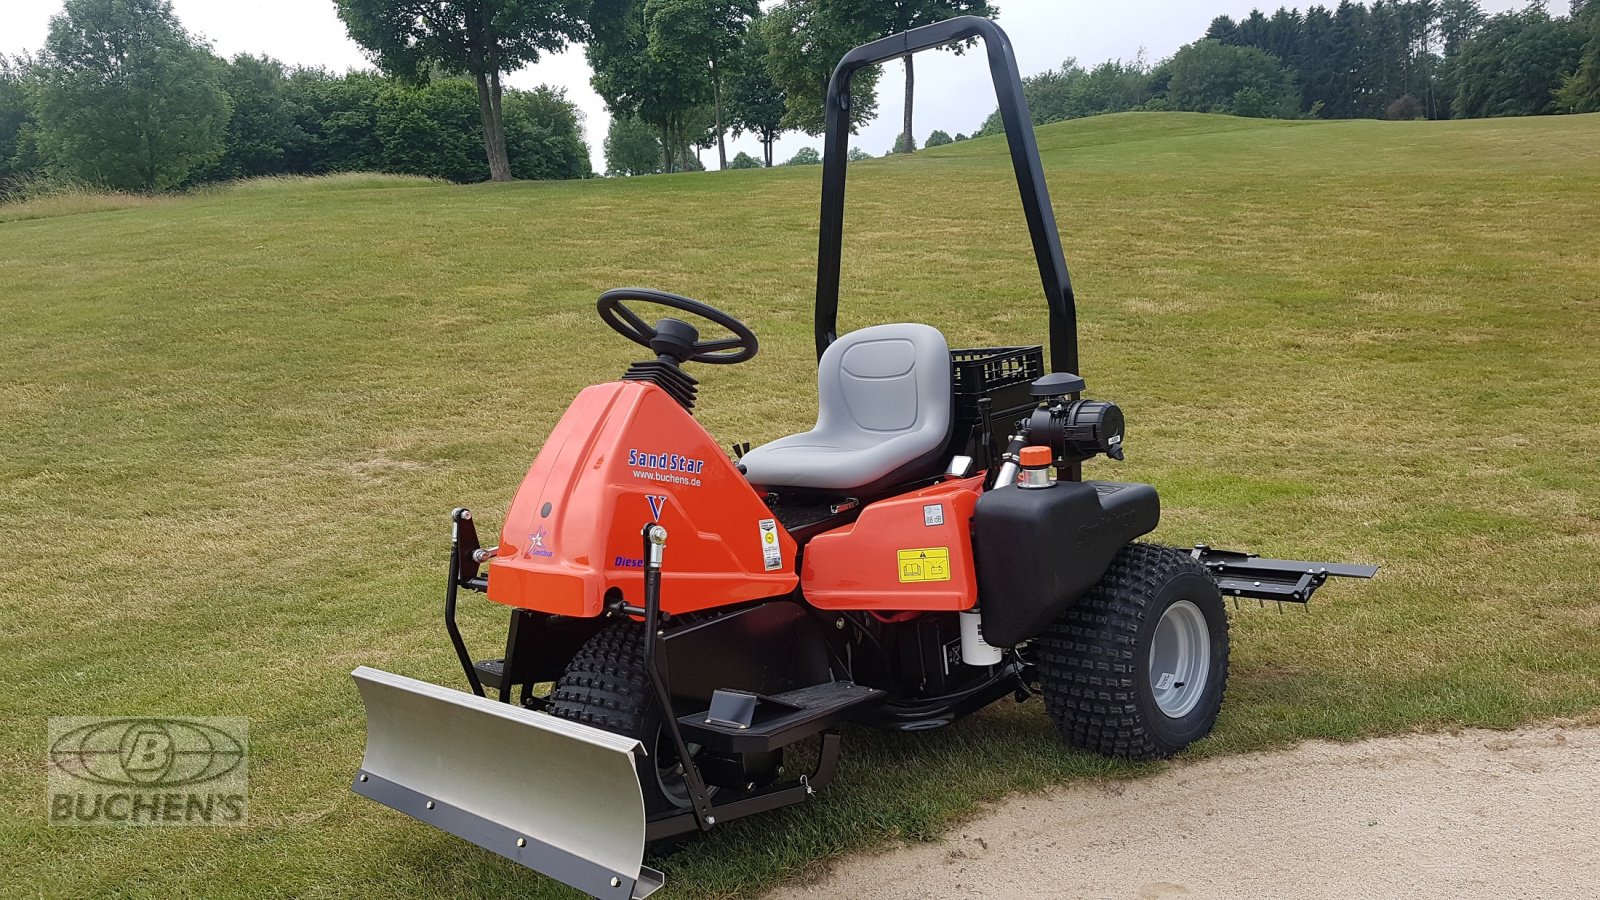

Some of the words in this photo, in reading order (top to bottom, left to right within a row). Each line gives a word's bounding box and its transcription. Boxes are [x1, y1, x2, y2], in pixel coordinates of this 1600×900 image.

[633, 469, 701, 486] www.buchens.de
[645, 495, 667, 522] V
[615, 556, 645, 567] Diese
